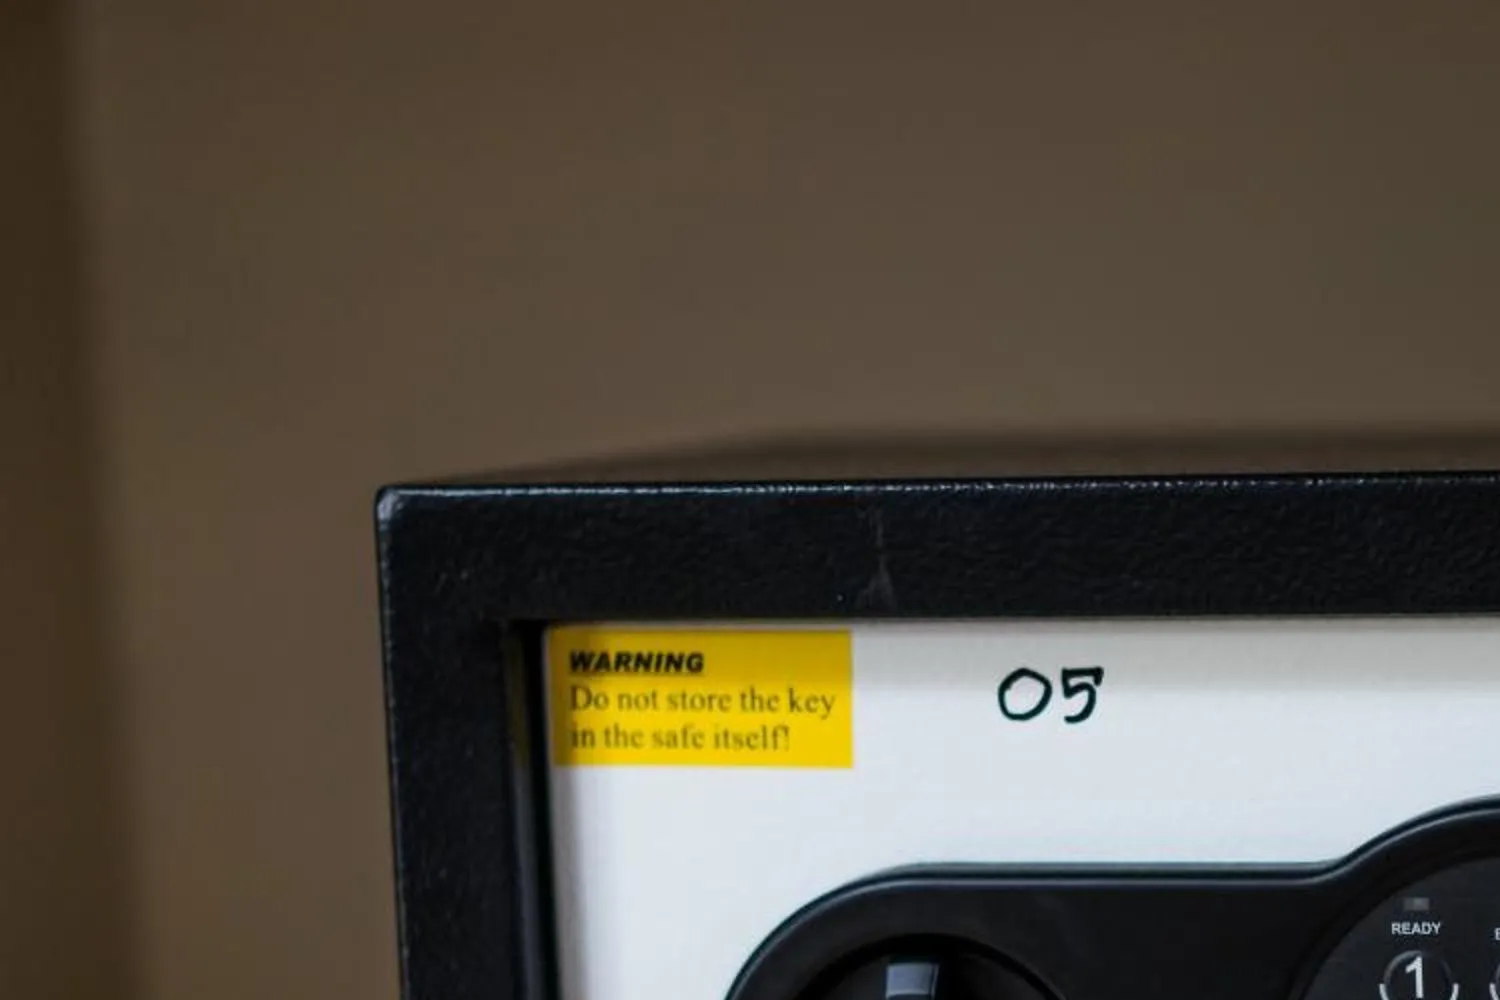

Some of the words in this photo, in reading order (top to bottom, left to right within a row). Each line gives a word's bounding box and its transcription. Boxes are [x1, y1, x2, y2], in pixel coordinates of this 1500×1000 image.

[569, 651, 704, 673] WARNING
[570, 685, 609, 712] Do
[616, 688, 658, 712] not
[667, 690, 732, 712] store
[740, 687, 780, 714] the
[788, 687, 836, 720] key
[998, 666, 1104, 724] 05
[571, 723, 596, 748] in
[603, 723, 644, 749] the
[651, 724, 704, 749] safe
[714, 724, 790, 751] itself!
[1391, 922, 1441, 935] READY
[1405, 956, 1424, 999] 1
